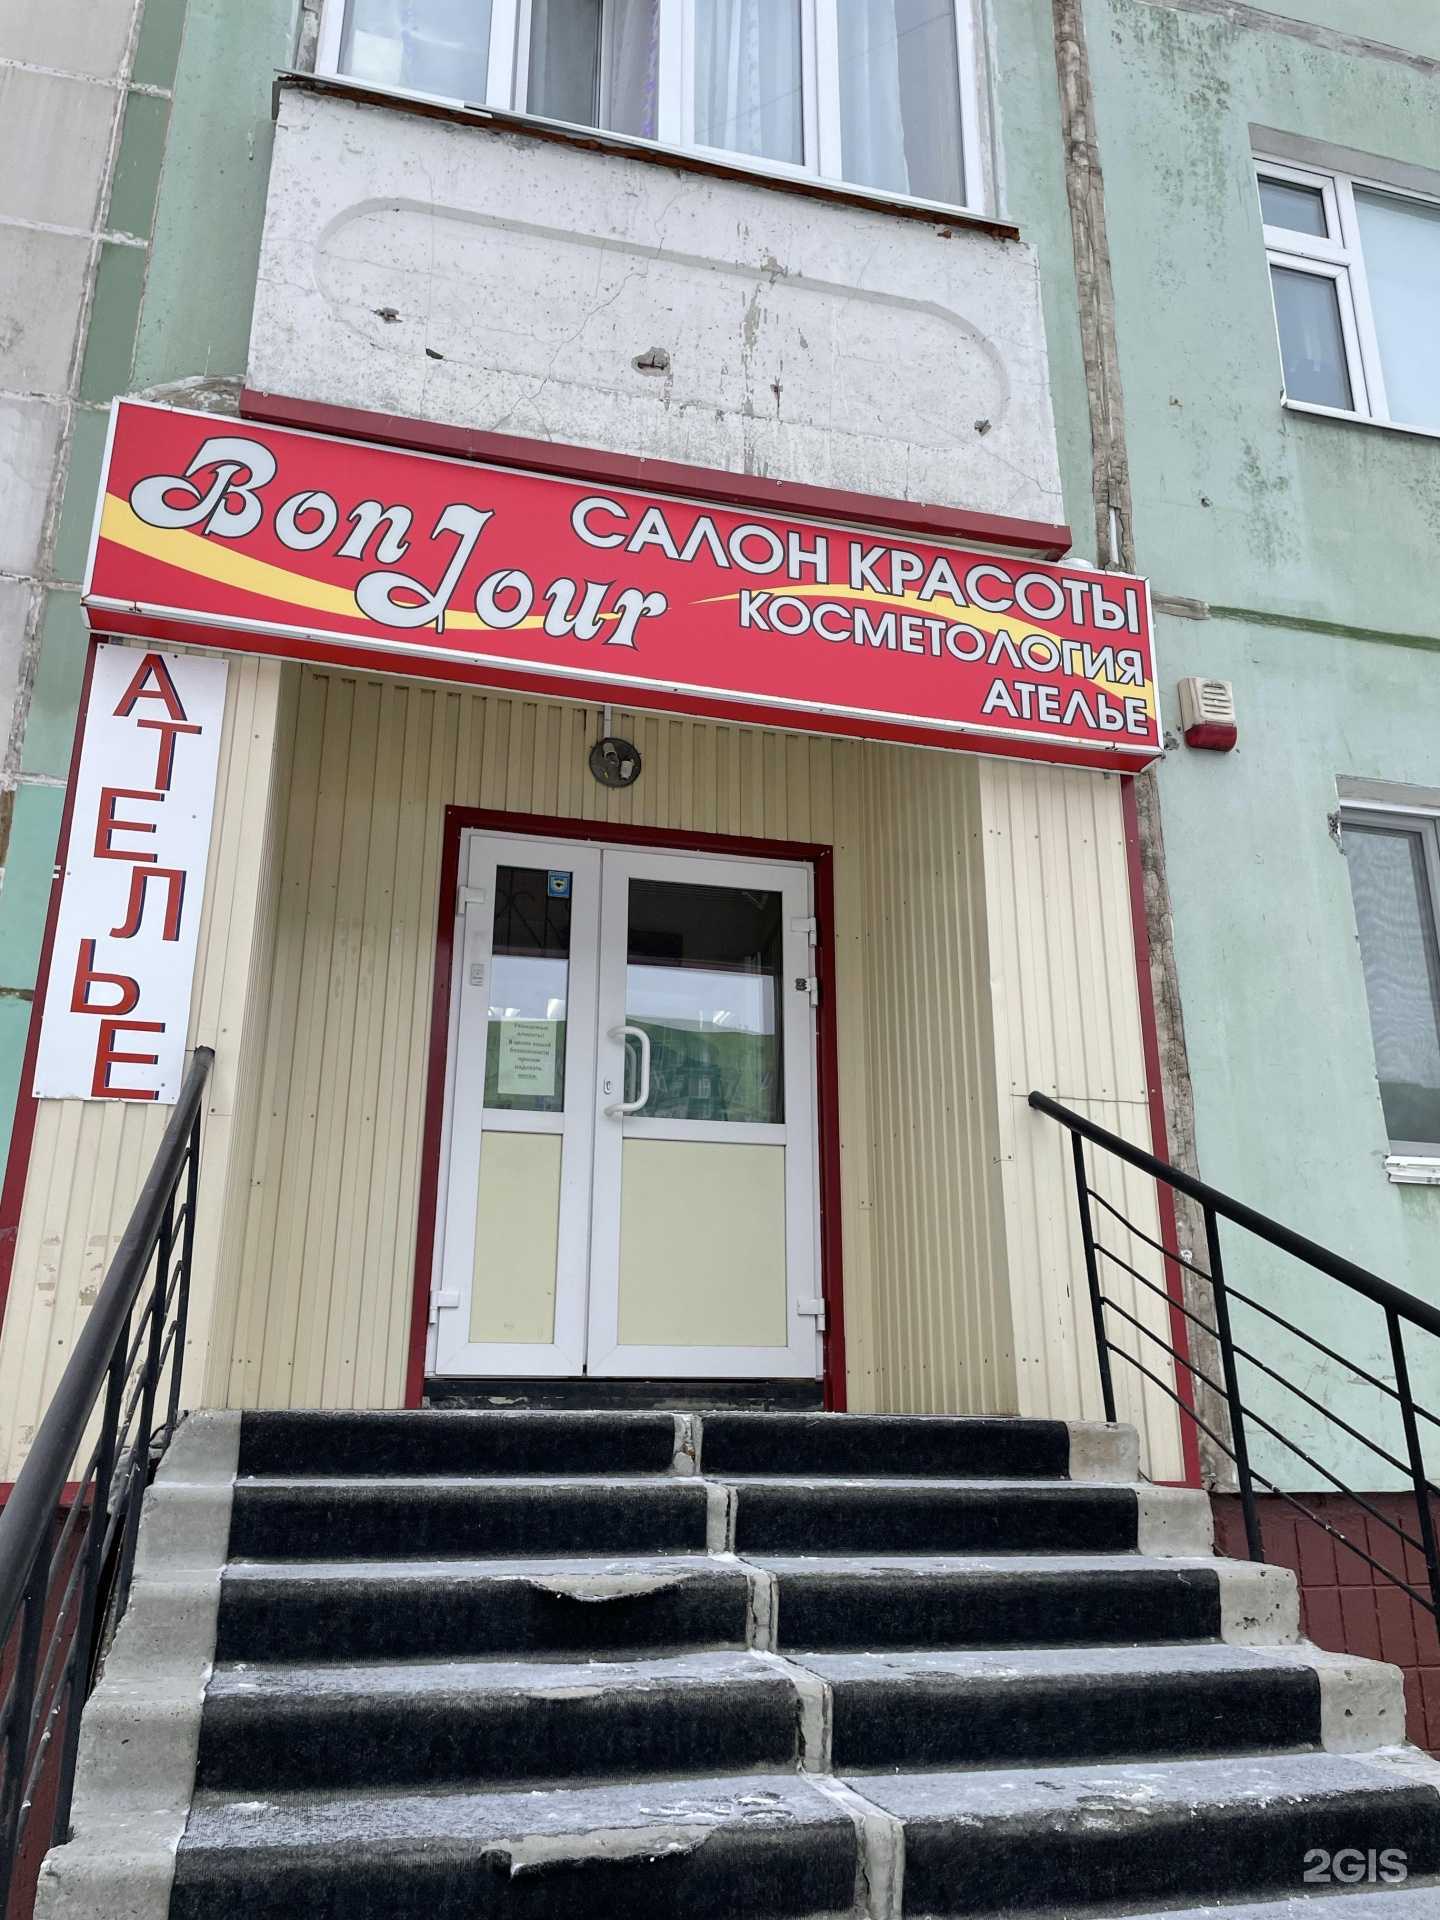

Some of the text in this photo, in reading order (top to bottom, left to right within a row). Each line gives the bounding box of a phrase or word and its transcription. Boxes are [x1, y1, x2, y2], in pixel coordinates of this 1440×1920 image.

[129, 436, 668, 651] Bon Jour
[570, 496, 1141, 634] САЛОН КРАСОТЫ
[738, 588, 1146, 687] КОСМЕТОЛОГИЯ
[981, 677, 1150, 736] АТЕЛЬЕ
[70, 653, 202, 1100] АТЕЛЬЕ
